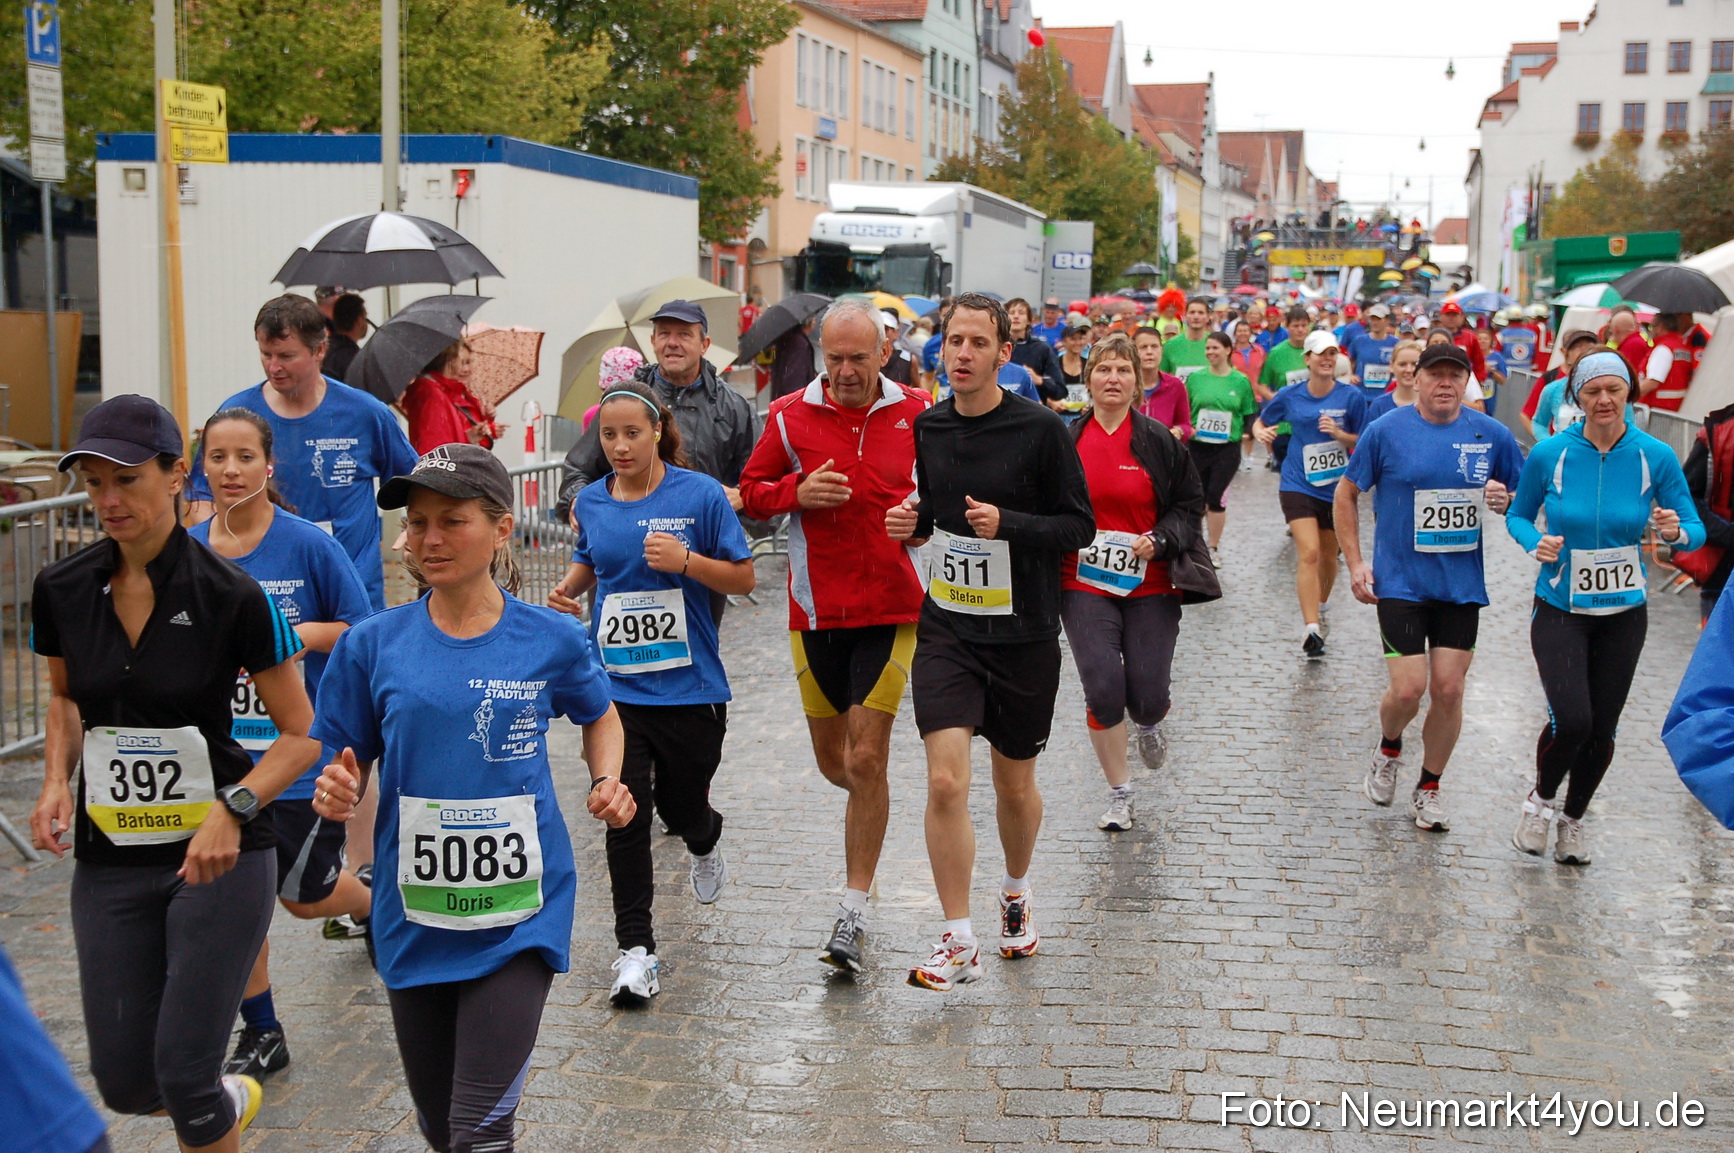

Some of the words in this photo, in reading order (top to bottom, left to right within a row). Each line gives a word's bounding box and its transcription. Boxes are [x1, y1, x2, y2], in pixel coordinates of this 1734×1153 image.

[167, 103, 215, 125] betreuung
[1052, 251, 1093, 270] BO
[1305, 253, 1345, 263] START
[1200, 418, 1227, 432] 2765
[1309, 451, 1345, 471] 2926
[637, 519, 648, 527] 12.
[1422, 505, 1477, 529] 2958
[950, 539, 981, 551] BOCK
[1433, 534, 1467, 544] Thomas
[1085, 545, 1140, 575] 3134
[943, 553, 989, 586] 511
[1579, 564, 1635, 591] 3012
[949, 588, 984, 604] Stefan
[1592, 596, 1626, 606] Renate
[606, 612, 678, 645] 2982
[627, 649, 660, 662] Talita
[468, 679, 487, 689] 12.
[484, 689, 539, 700] STADTLAUF
[235, 726, 276, 737] amara
[116, 735, 162, 747] BOCK
[109, 759, 186, 803] 392
[116, 812, 183, 828] Barbara
[440, 808, 497, 821] BOCK
[414, 832, 528, 883] 5083
[447, 892, 494, 912] Doris
